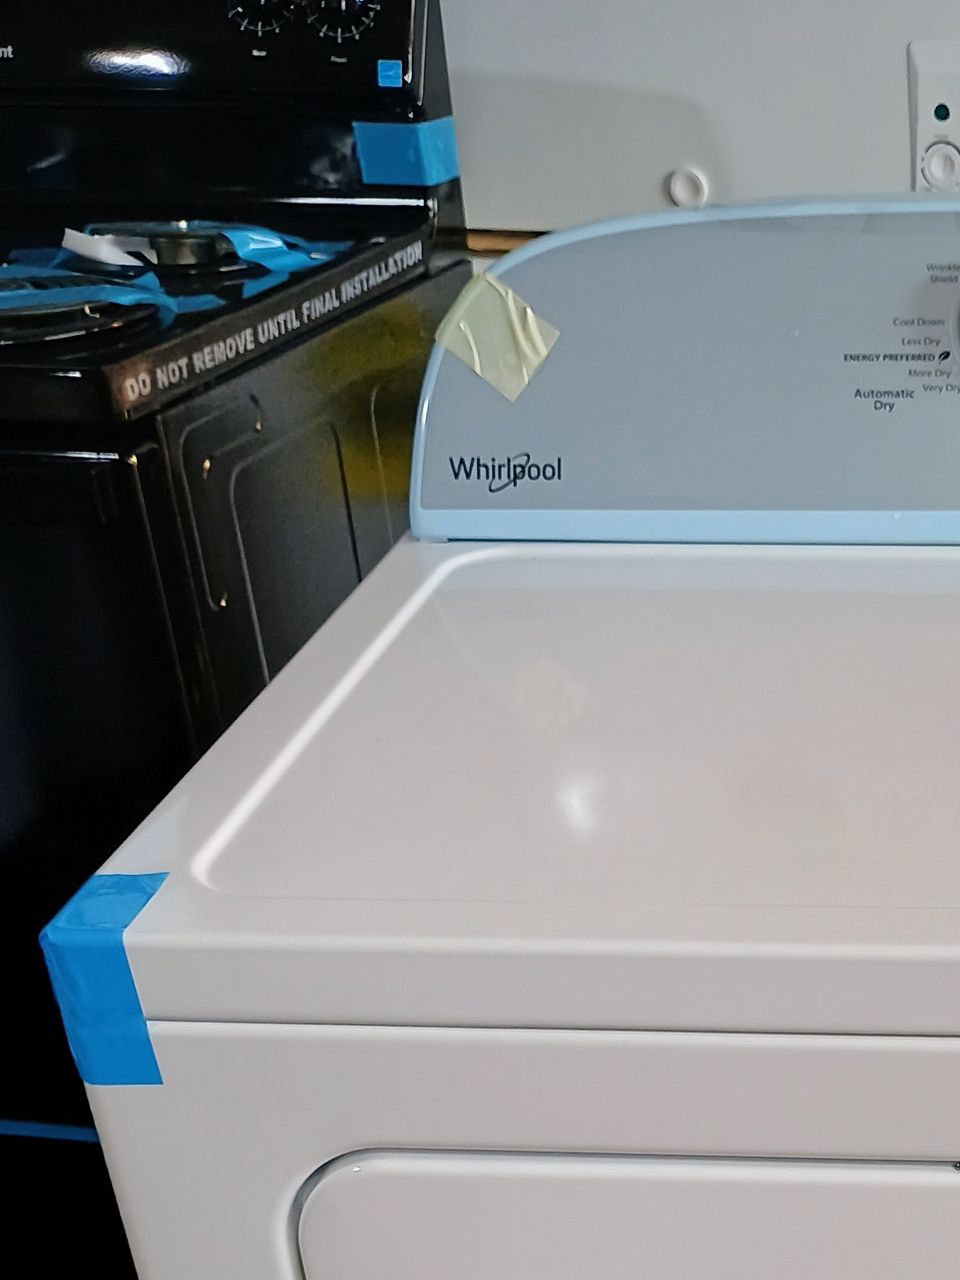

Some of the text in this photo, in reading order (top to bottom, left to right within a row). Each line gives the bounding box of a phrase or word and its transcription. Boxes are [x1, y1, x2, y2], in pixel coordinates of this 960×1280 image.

[126, 240, 423, 401] DO NOT REMOVE UNTIL FINAL INSTALLATION
[893, 317, 945, 327] Cool Down
[901, 337, 941, 347] Less Dry
[844, 353, 935, 362] ENERGY PREFERRED
[908, 369, 952, 379] More Dry
[854, 388, 915, 399] Automatic
[922, 384, 943, 394] Very
[874, 400, 895, 413] Dry
[449, 454, 562, 491] Whirlpool
